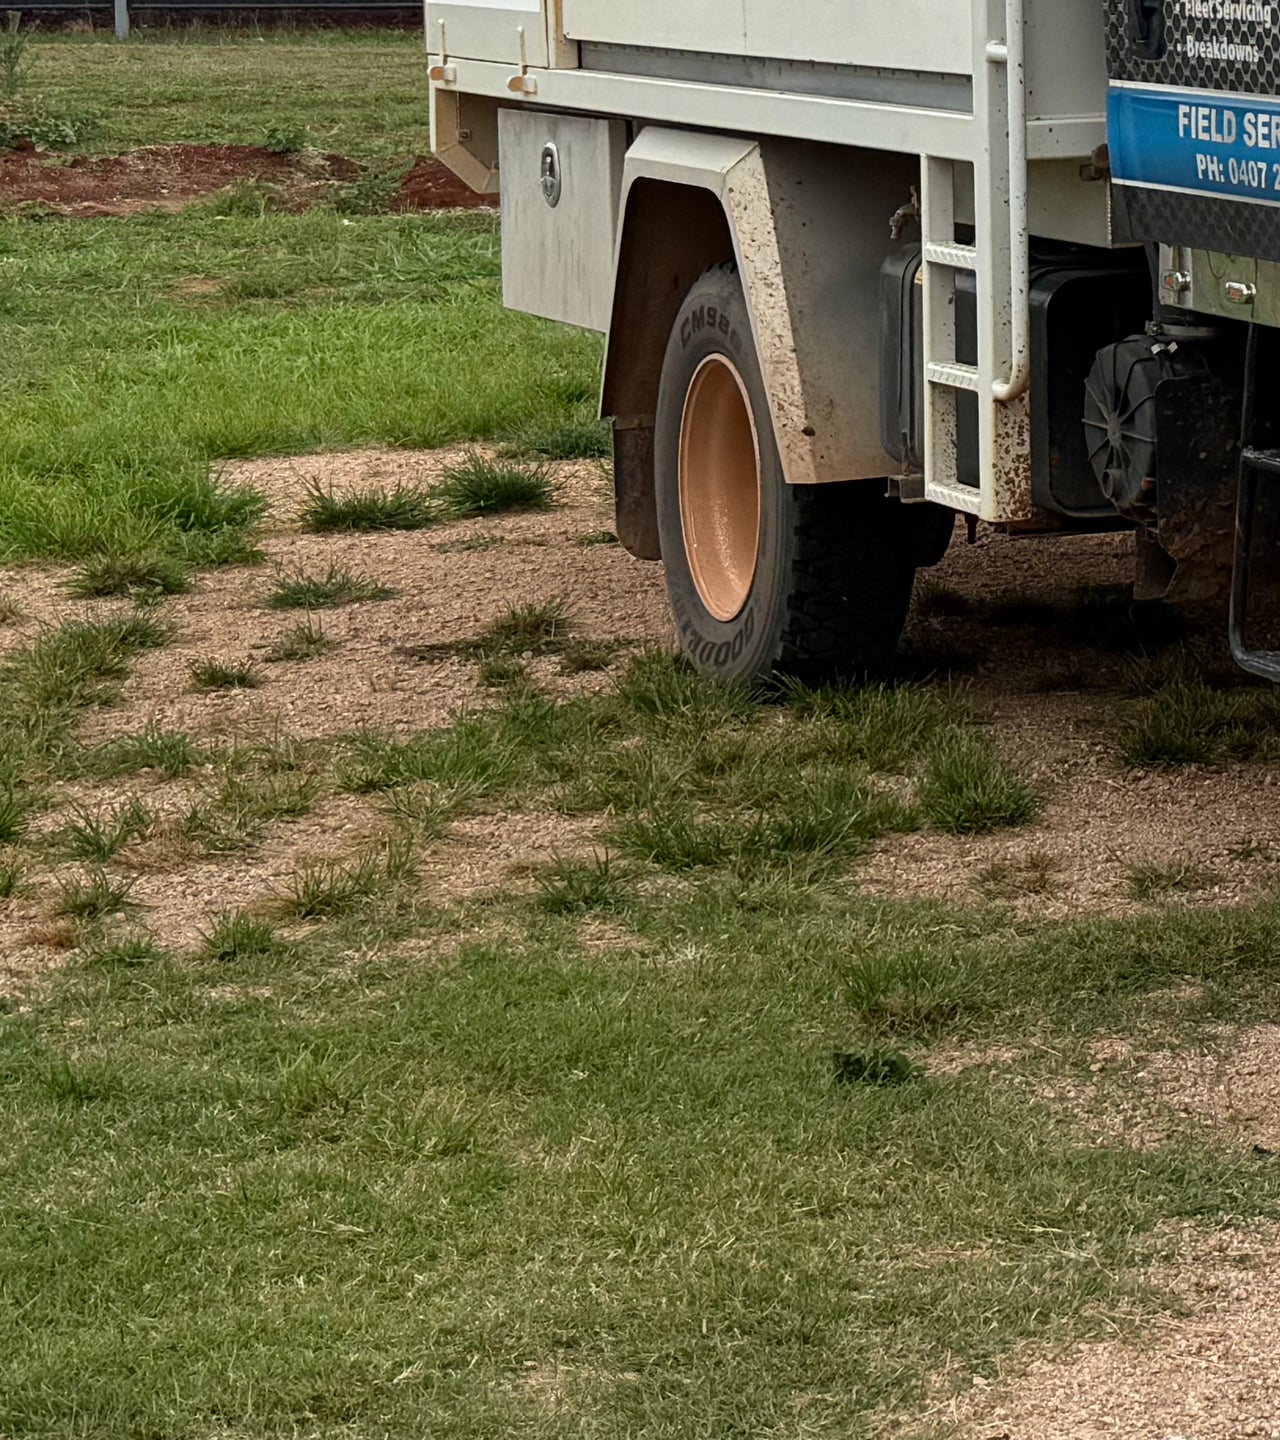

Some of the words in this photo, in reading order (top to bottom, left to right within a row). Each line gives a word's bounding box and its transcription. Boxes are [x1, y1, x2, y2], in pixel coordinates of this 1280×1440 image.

[1186, 35, 1260, 63] Breakdowns
[1178, 104, 1237, 144] FIELD
[1196, 153, 1225, 183] PH:
[1228, 157, 1267, 189] 0407
